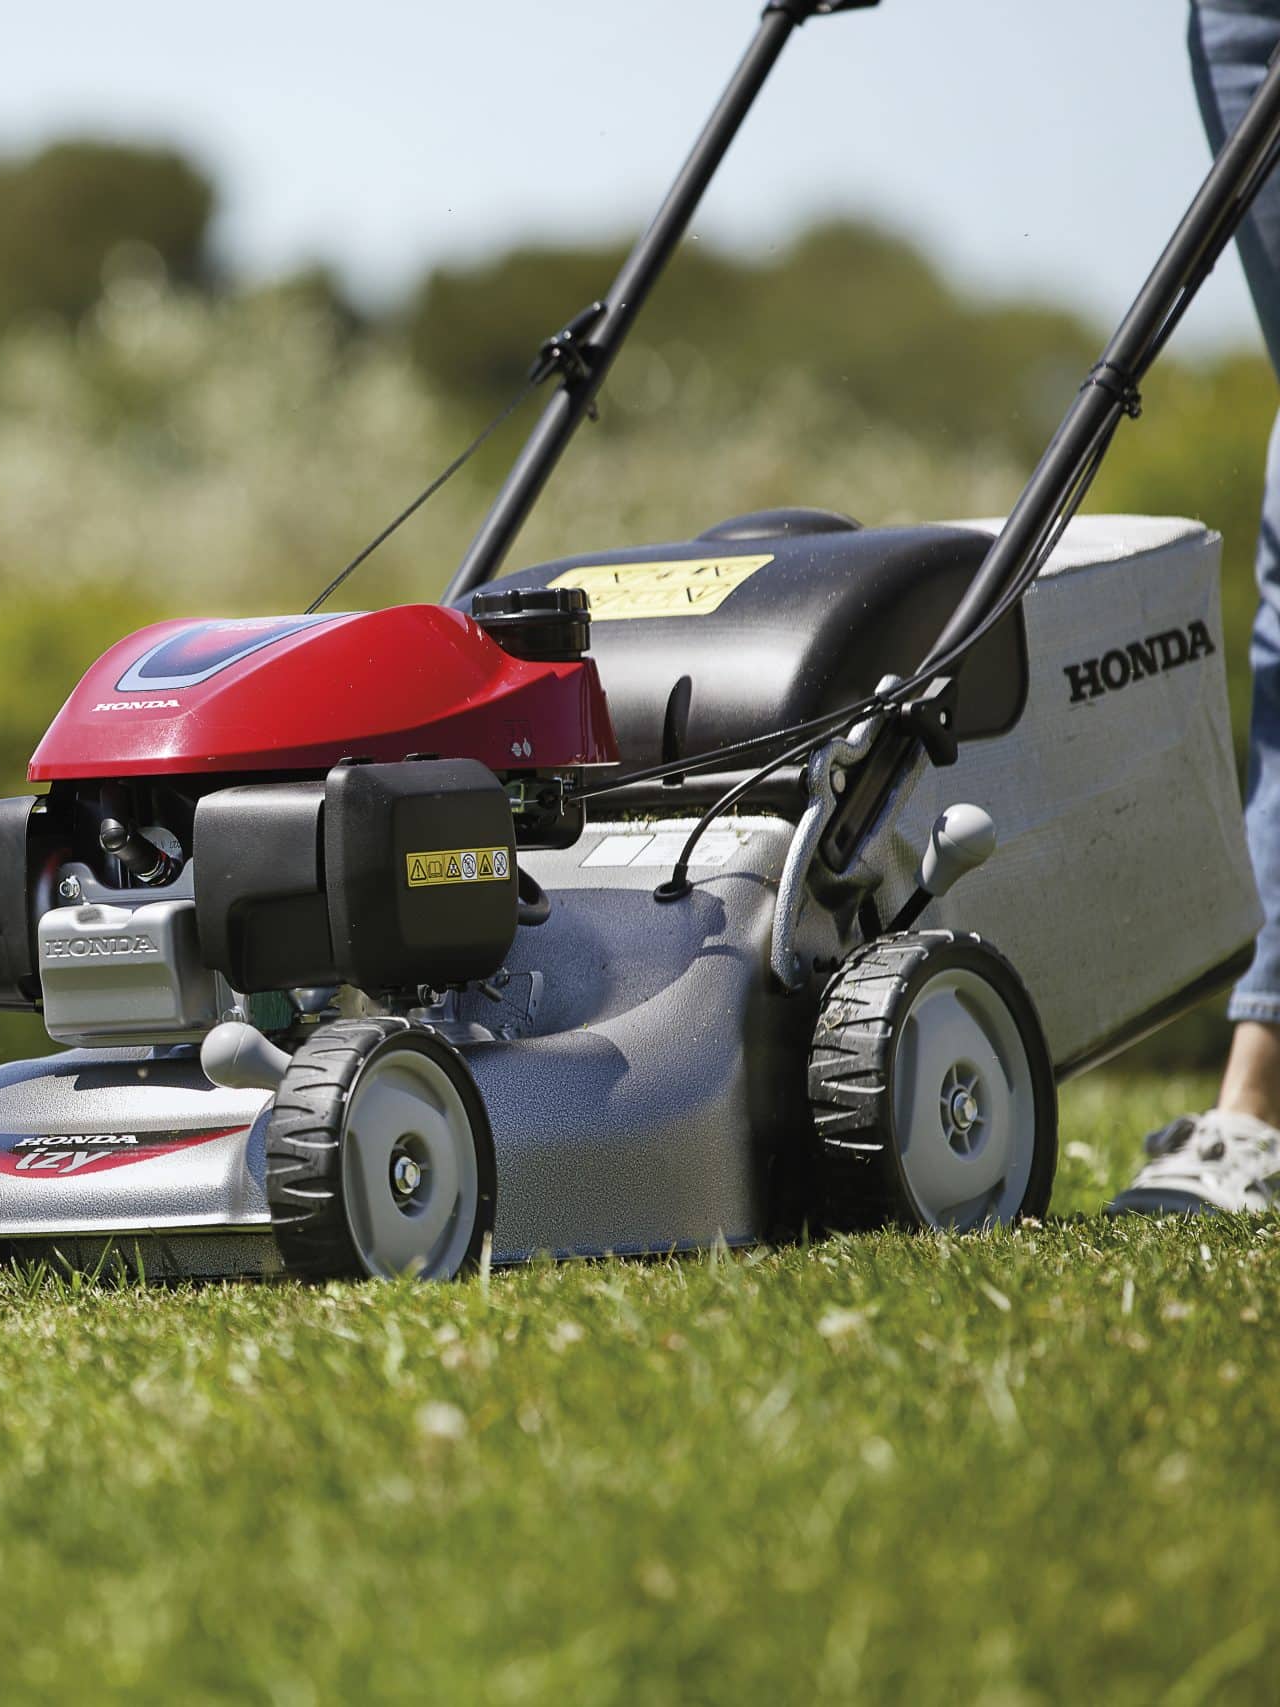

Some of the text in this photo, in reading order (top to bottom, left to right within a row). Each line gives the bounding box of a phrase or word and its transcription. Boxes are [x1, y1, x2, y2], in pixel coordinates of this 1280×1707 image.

[1064, 619, 1215, 703] HONDA
[92, 699, 180, 712] HONDA
[45, 935, 159, 958] HONDA
[15, 1134, 139, 1147] HONDA
[15, 1148, 113, 1174] izy
